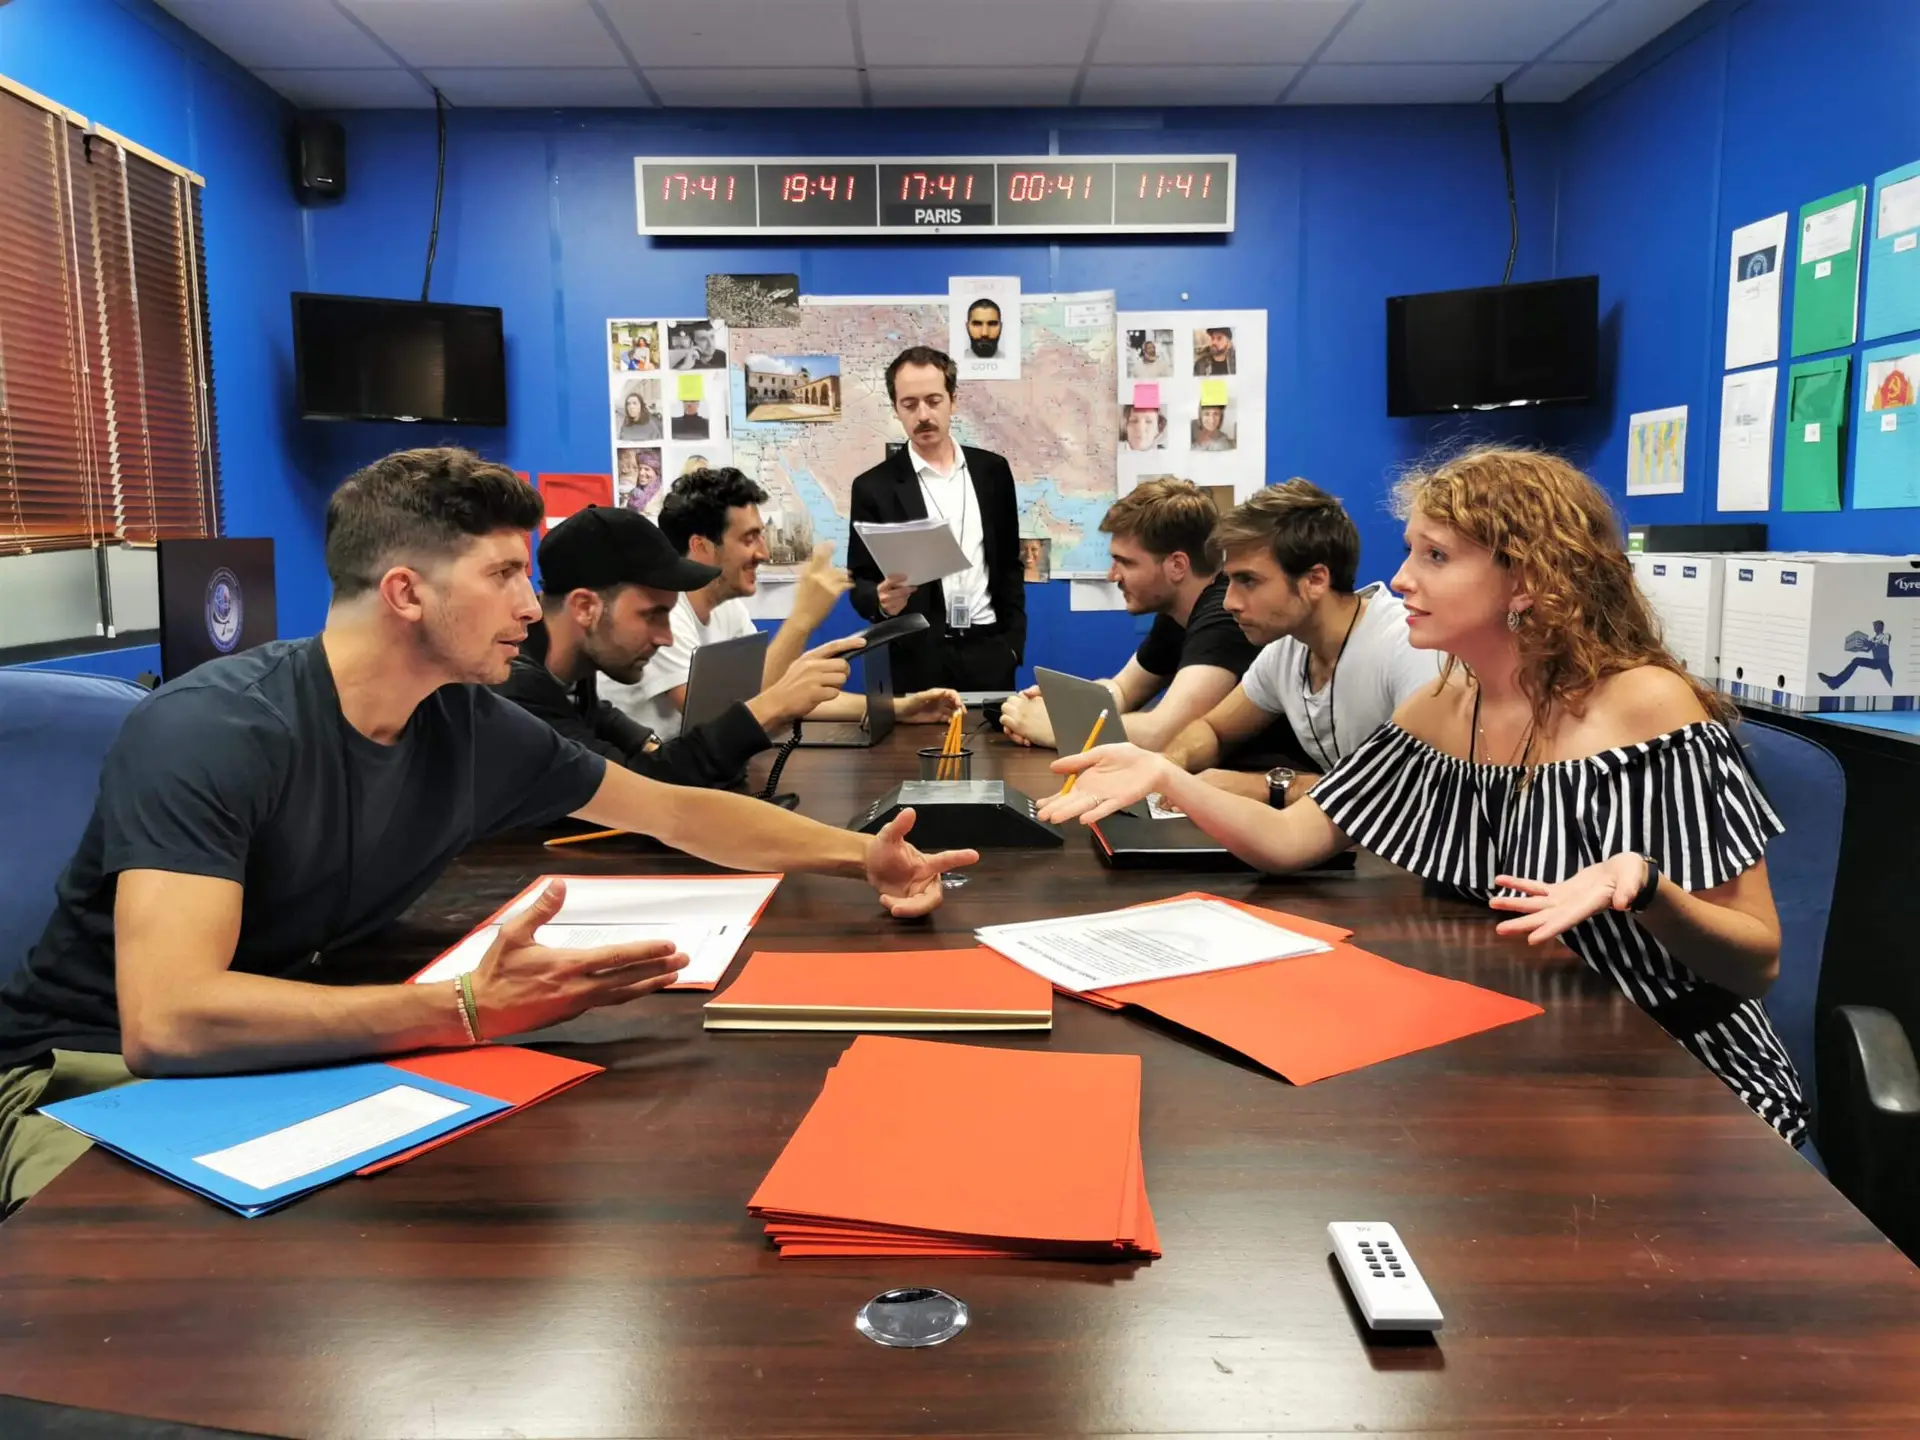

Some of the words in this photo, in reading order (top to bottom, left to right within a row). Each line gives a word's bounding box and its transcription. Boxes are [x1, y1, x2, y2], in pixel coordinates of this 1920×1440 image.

[662, 174, 735, 201] 17:41
[782, 174, 855, 203] 19:41
[901, 173, 974, 201] 17:41
[1009, 173, 1093, 202] 00:41
[1139, 173, 1212, 199] 11:41
[914, 208, 962, 224] PARIS
